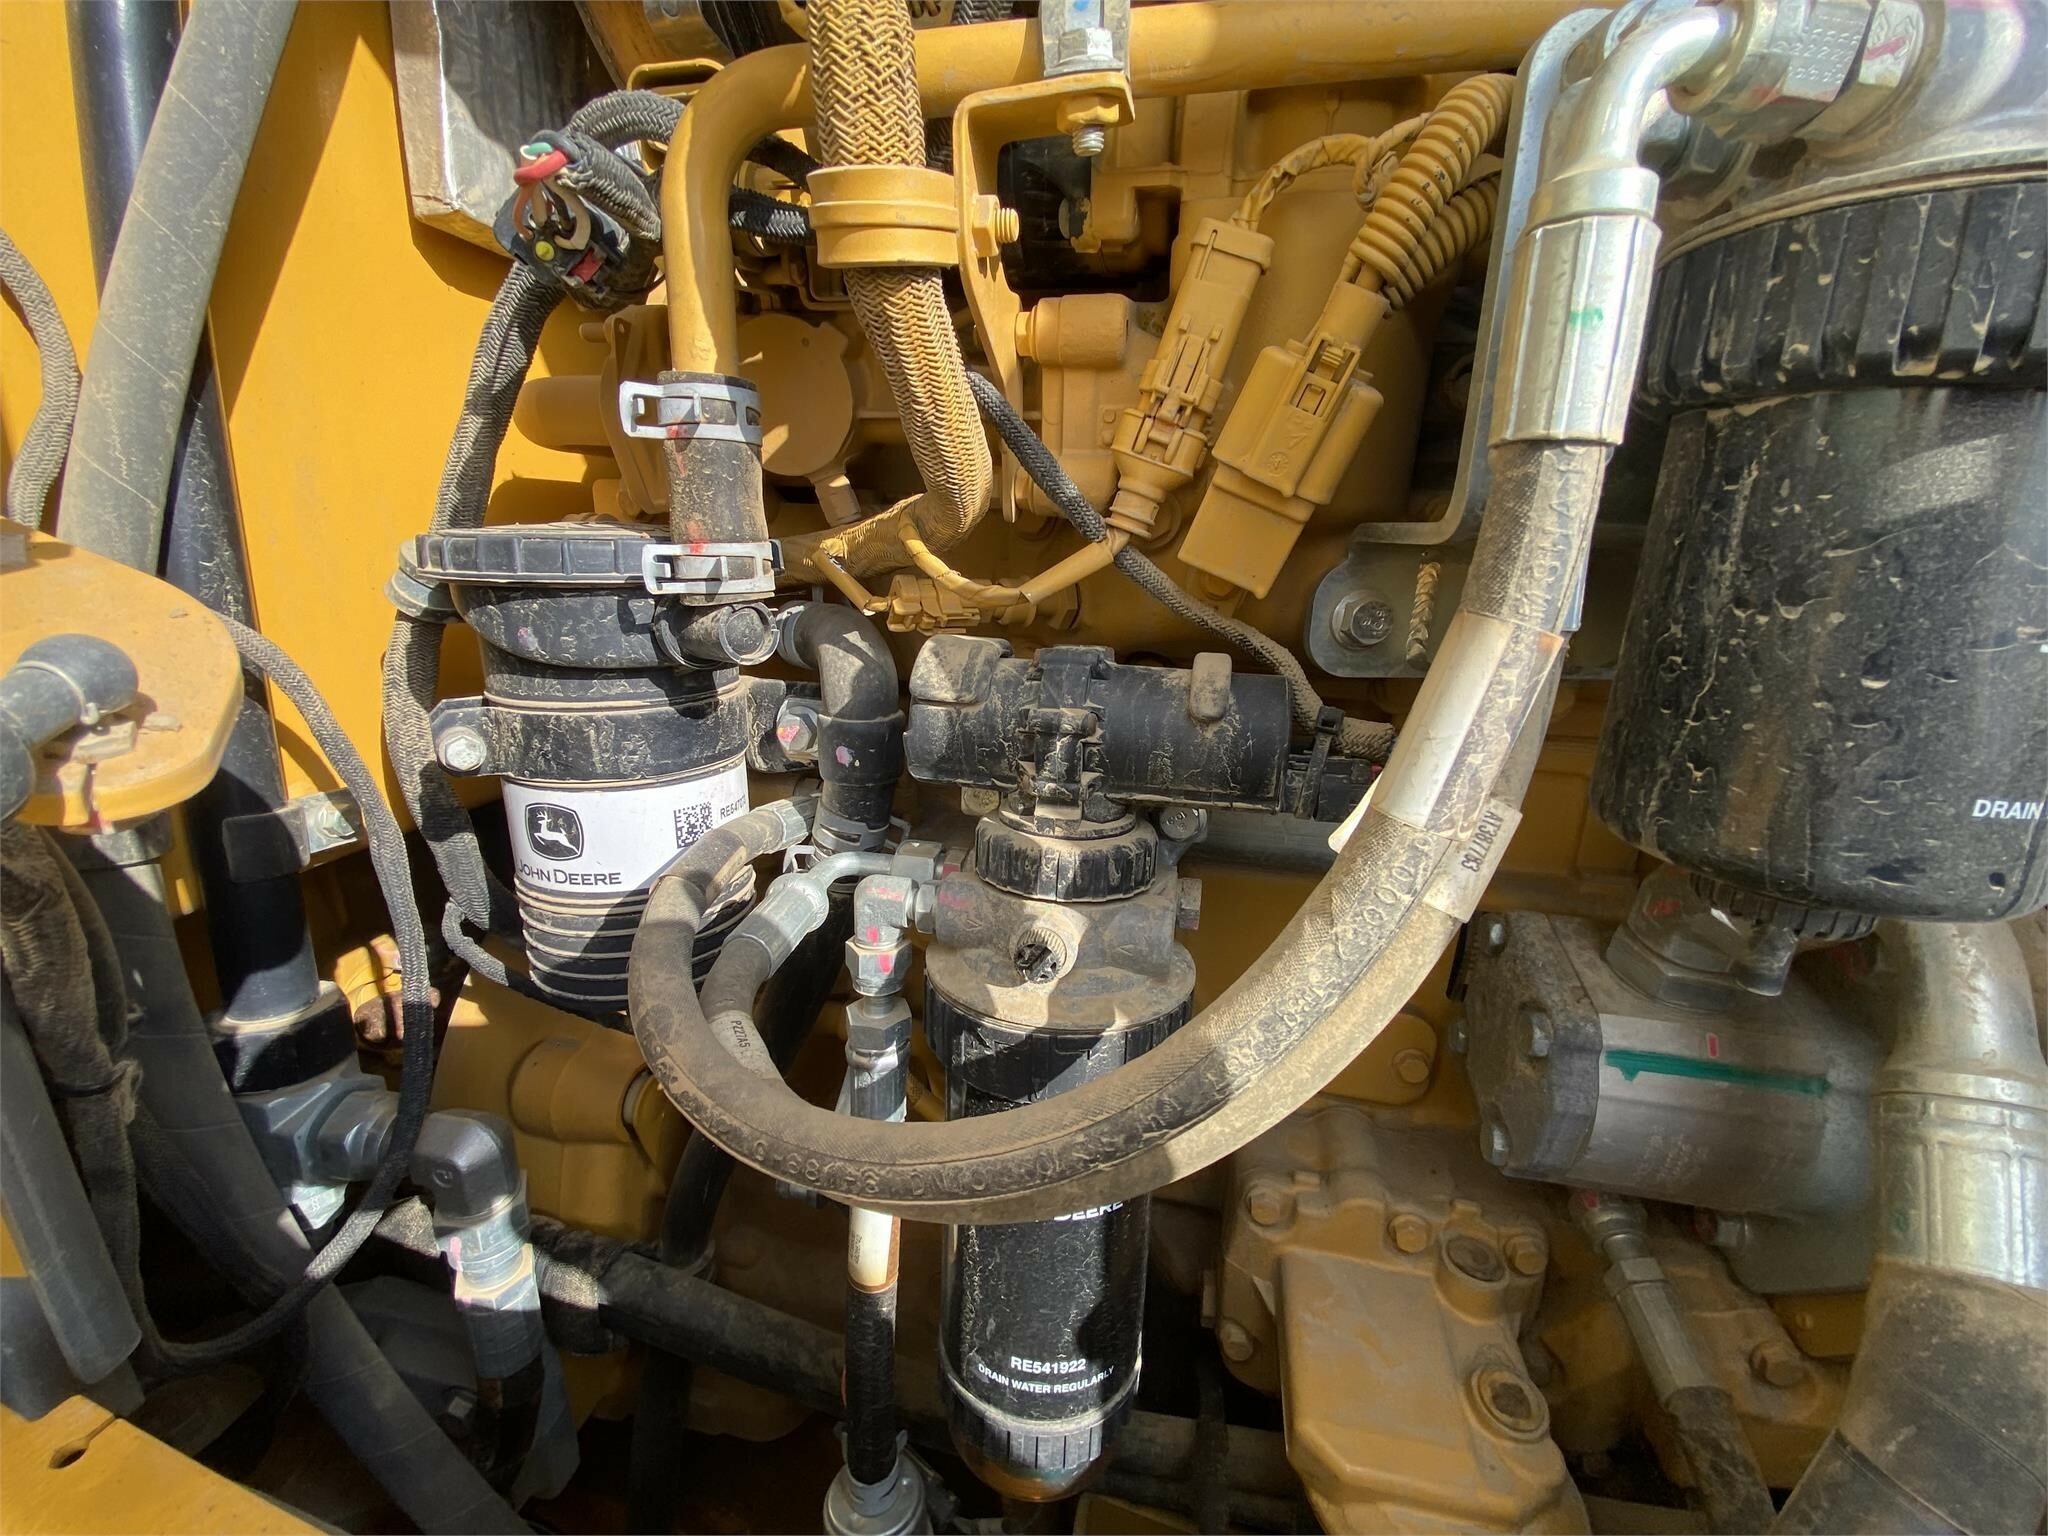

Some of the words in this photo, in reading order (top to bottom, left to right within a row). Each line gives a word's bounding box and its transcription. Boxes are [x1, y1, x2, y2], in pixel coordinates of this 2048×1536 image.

[1971, 799, 2045, 820] DRAIN
[519, 860, 552, 882] JOHN
[553, 868, 622, 886] DEERE
[1010, 1356, 1087, 1375] RE541922
[978, 1363, 1010, 1386] DRAIN
[1011, 1379, 1051, 1394] WATER
[1053, 1365, 1114, 1394] REGULARLY
